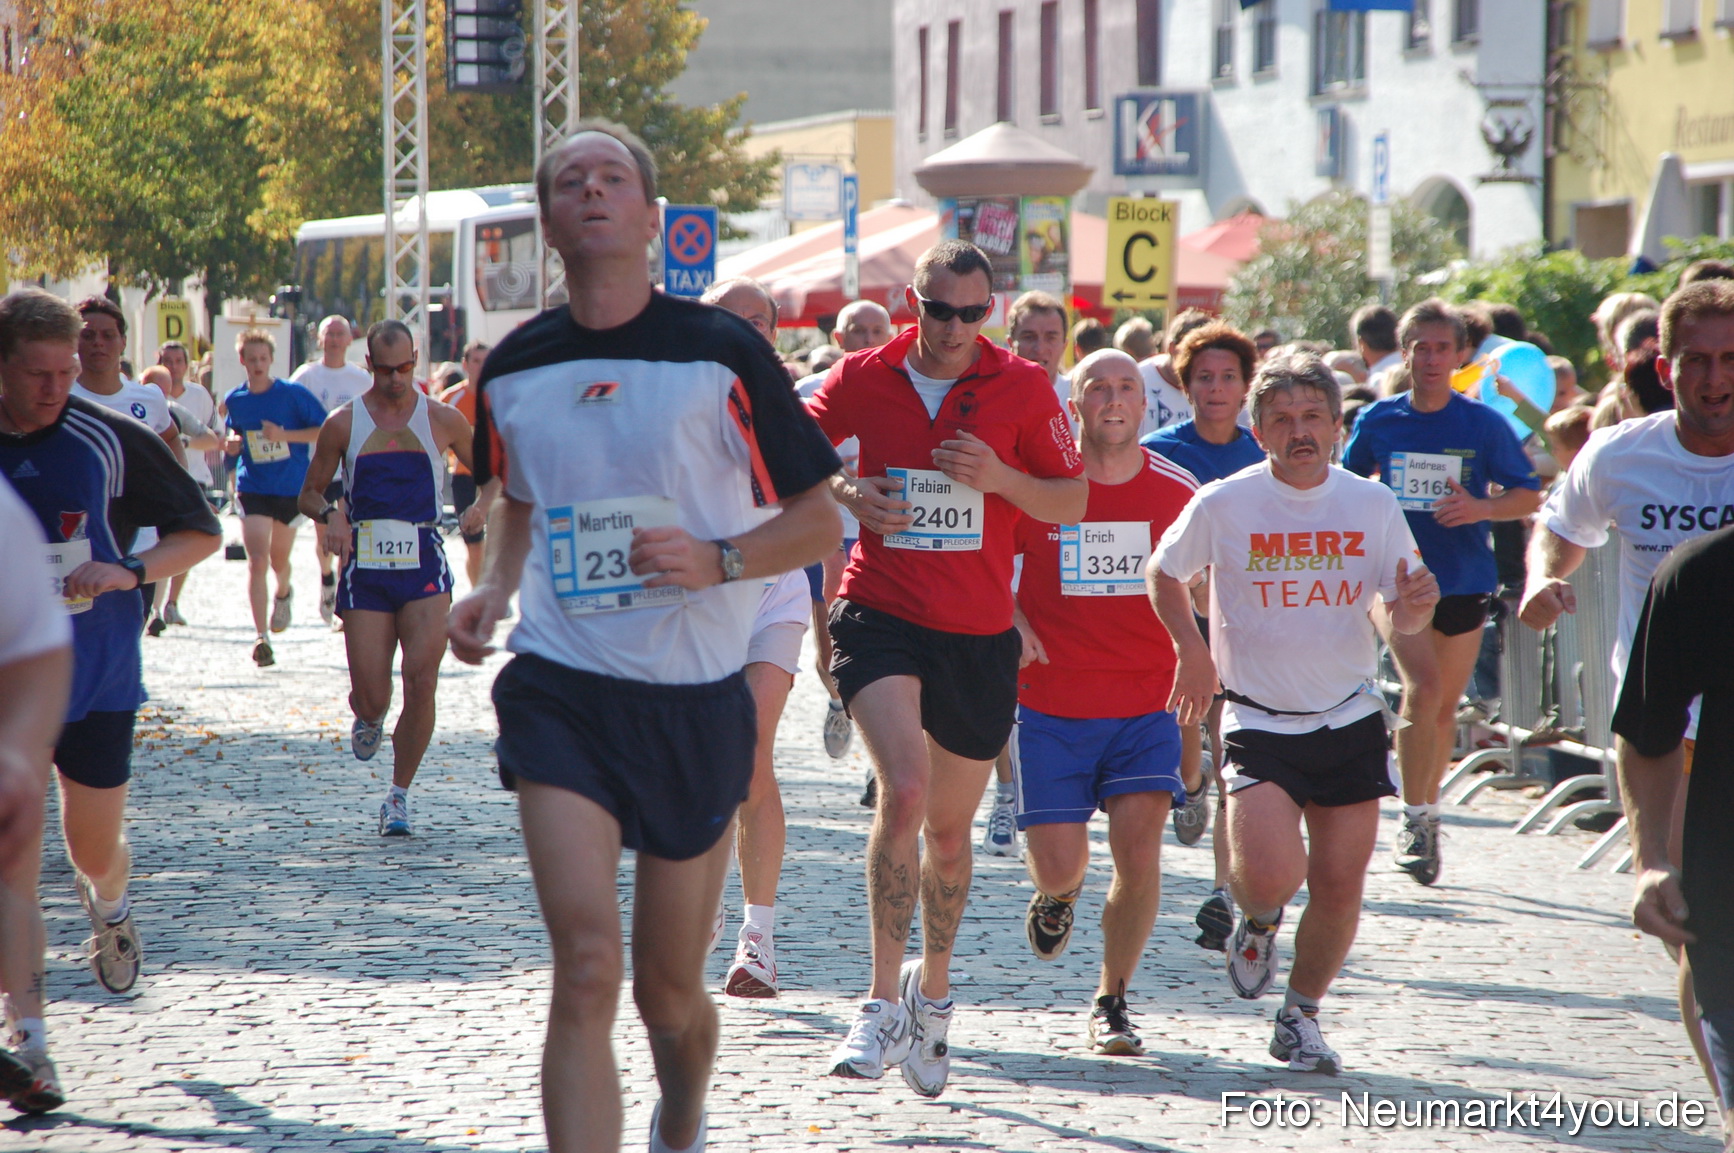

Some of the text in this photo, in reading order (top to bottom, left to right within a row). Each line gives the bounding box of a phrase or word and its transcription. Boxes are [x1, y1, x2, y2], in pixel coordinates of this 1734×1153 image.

[1116, 202, 1171, 222] Block
[1123, 231, 1159, 283] C
[669, 269, 712, 291] TAXI
[166, 315, 183, 340] D
[1409, 459, 1447, 471] Andreas
[911, 477, 951, 494] Fabian
[1409, 479, 1454, 496] 3165
[578, 512, 634, 532] Martin
[912, 506, 972, 528] 2401
[1085, 530, 1115, 543] Erich
[1250, 531, 1365, 557] MERZ
[376, 541, 413, 554] 1217
[554, 549, 561, 564] B
[1064, 551, 1069, 561] B
[1087, 555, 1143, 575] 3347
[1245, 549, 1344, 572] Reisen
[1252, 580, 1362, 607] TEAM
